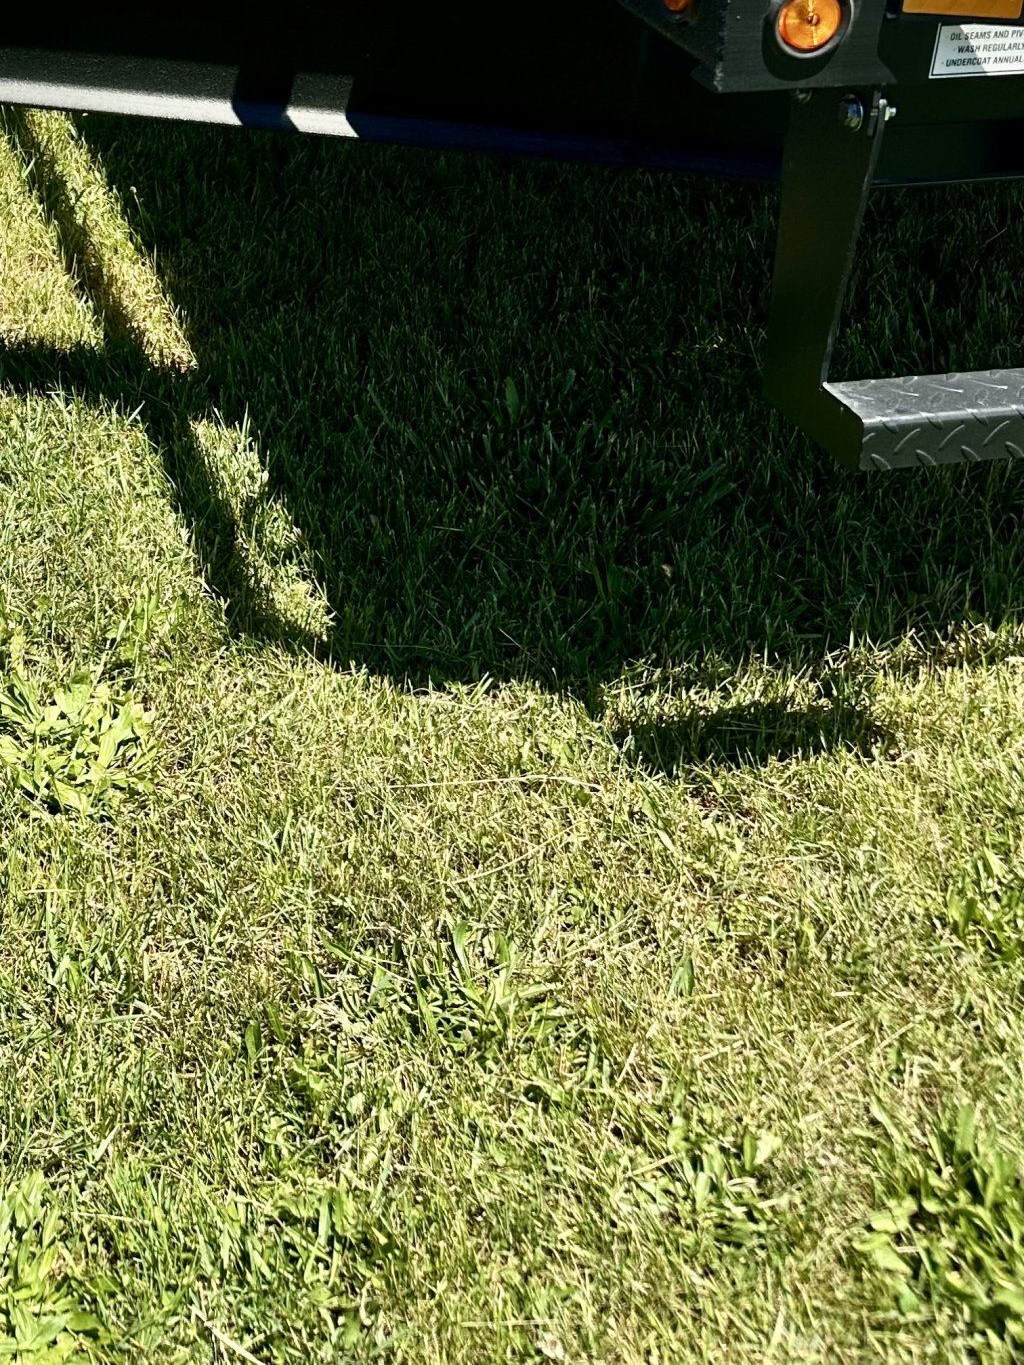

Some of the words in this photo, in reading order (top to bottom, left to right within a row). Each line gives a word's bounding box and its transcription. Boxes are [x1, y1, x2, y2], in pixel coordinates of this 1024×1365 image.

[950, 32, 963, 41] OIL
[965, 30, 991, 41] SEAMS
[993, 29, 1010, 39] AND
[1011, 29, 1024, 38] PIV
[957, 44, 980, 54] WASH
[945, 56, 992, 67] UNDERCOAT
[993, 55, 1024, 64] ANNUAL
